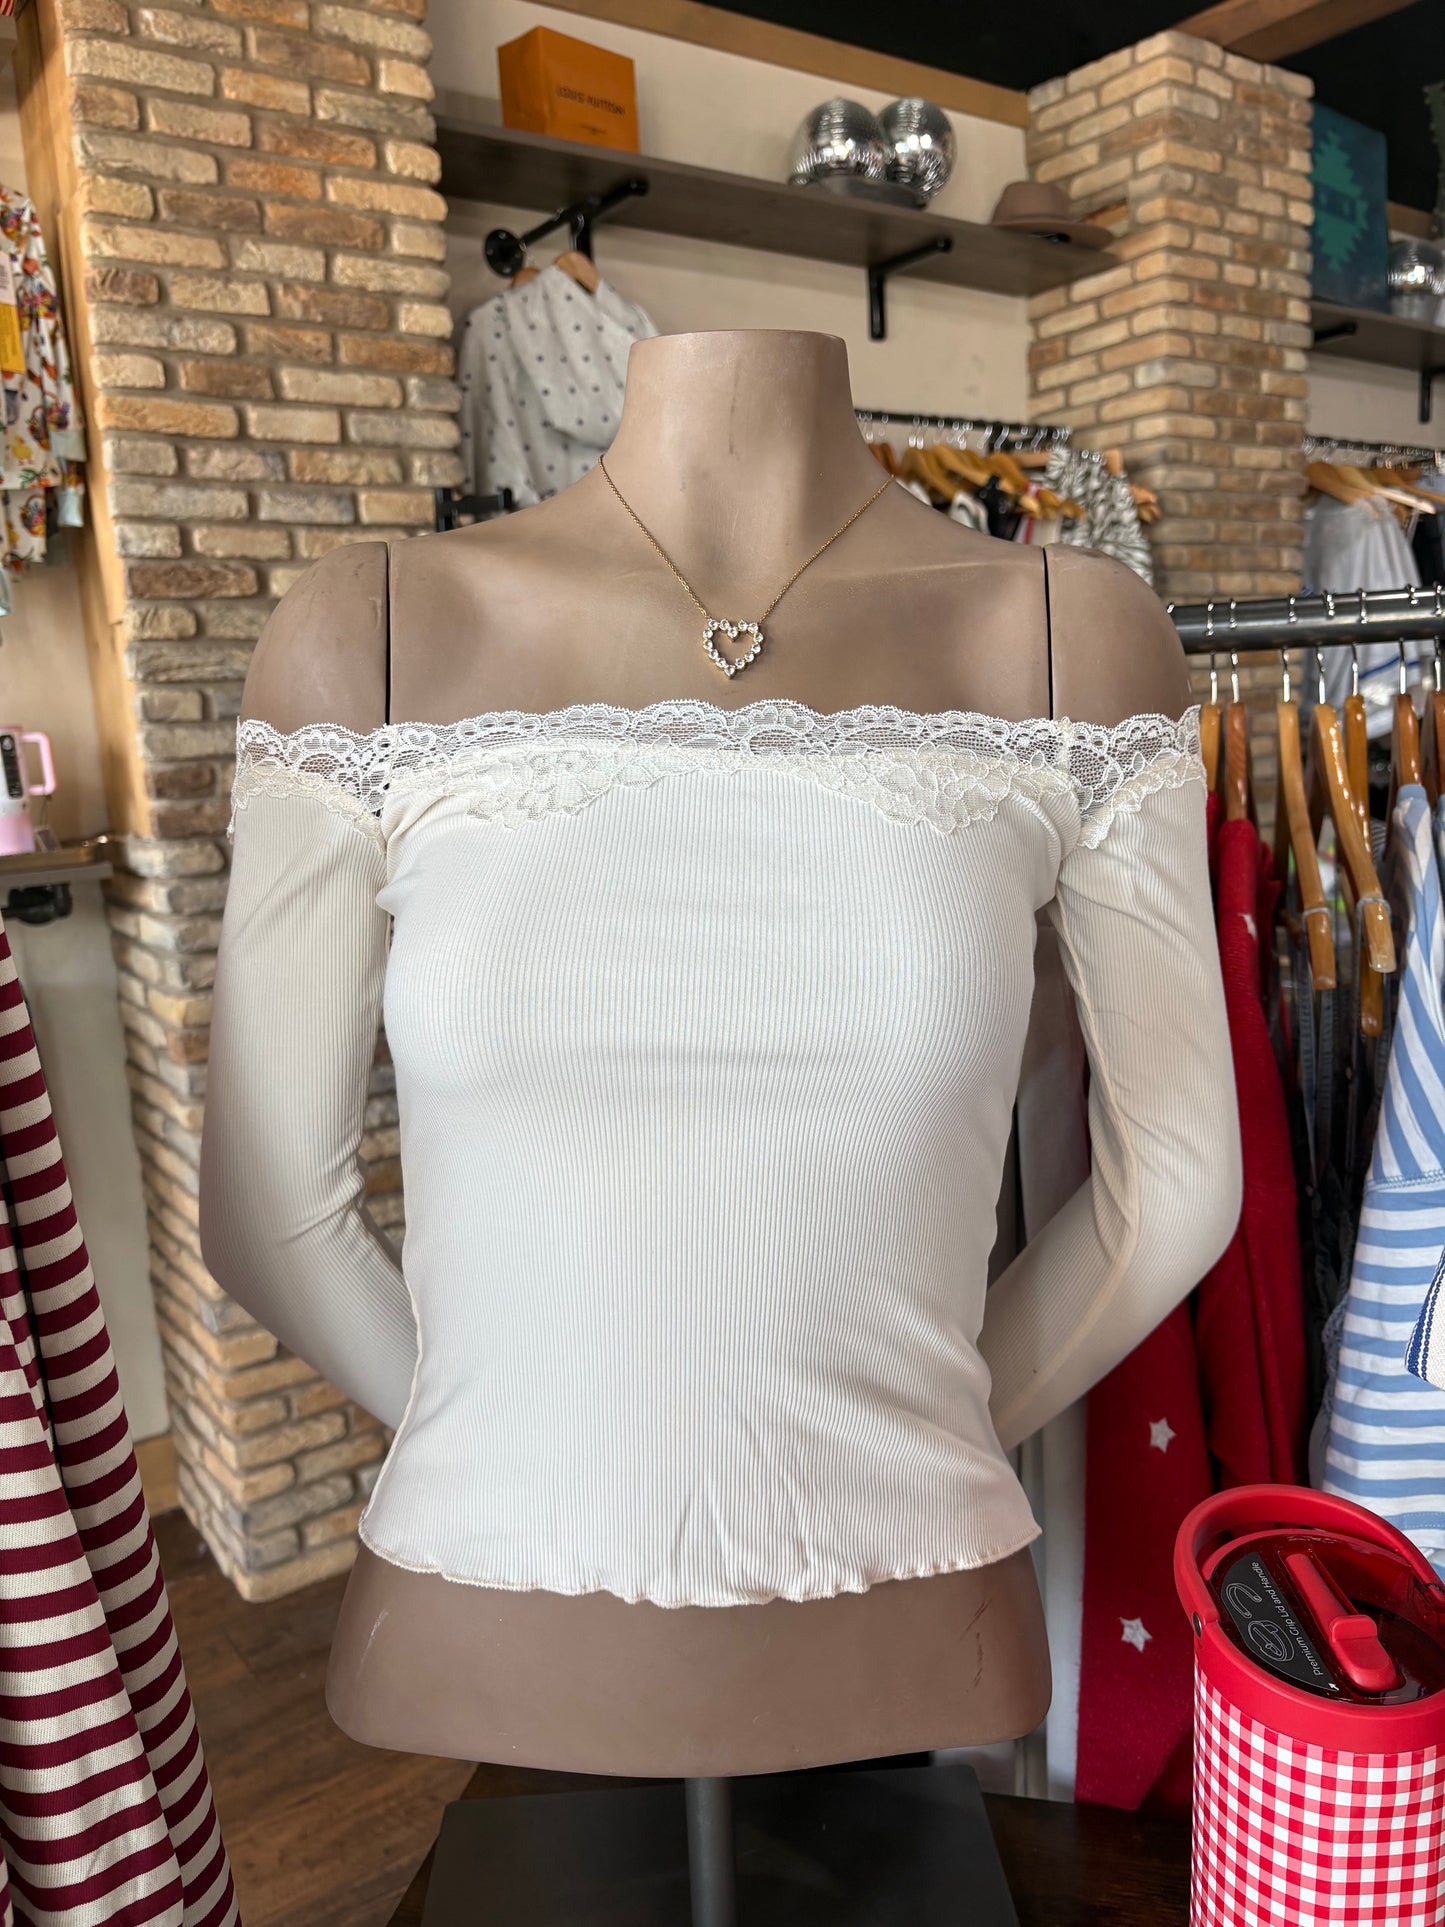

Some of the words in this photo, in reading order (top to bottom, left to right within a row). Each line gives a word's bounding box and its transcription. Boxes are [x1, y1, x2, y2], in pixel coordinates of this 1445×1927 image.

[557, 86, 585, 104] LOUIS
[1252, 1561, 1271, 1589] Handle
[1266, 1589, 1281, 1604] and
[1276, 1603, 1289, 1617] Lid
[1285, 1618, 1299, 1636] Grip
[1296, 1637, 1323, 1676] Premium
